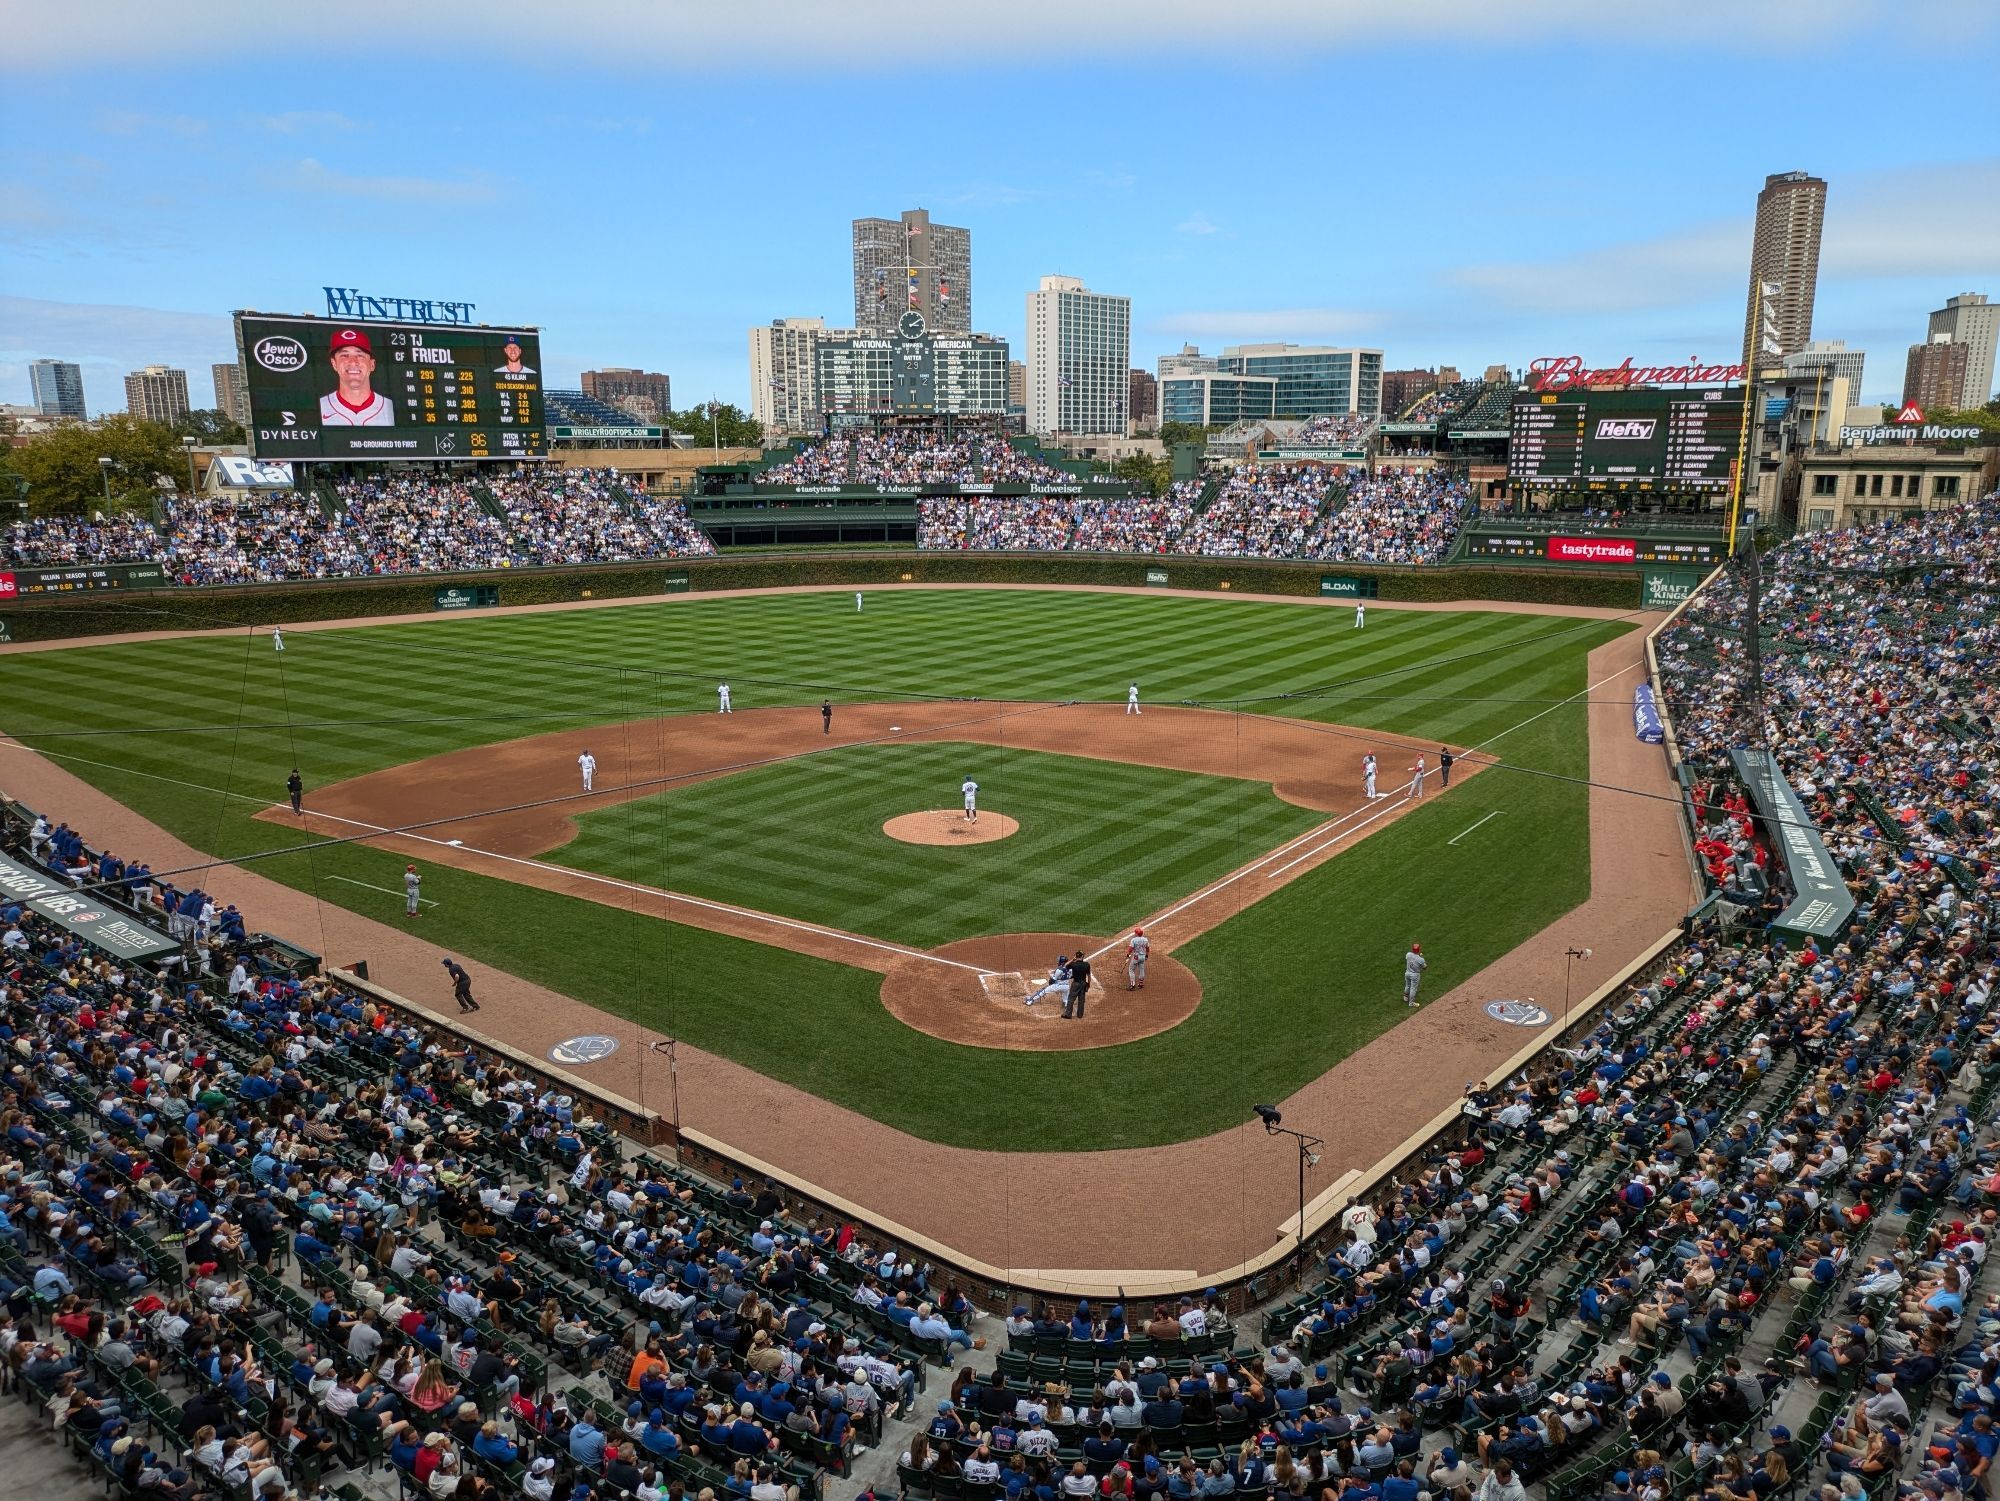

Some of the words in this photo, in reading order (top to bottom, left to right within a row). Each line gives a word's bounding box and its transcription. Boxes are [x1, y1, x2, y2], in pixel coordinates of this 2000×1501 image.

[322, 286, 476, 324] WINTRUST
[390, 334, 406, 345] 29
[410, 334, 422, 346] TJ
[261, 342, 297, 355] Jewel
[264, 354, 297, 365] Osco
[395, 352, 404, 361] CF
[412, 348, 454, 364] FRIEDL
[420, 370, 434, 380] 293
[459, 372, 473, 380] .225
[1530, 355, 1748, 391] Budweiser
[425, 385, 432, 394] 13
[461, 386, 473, 395] .310
[1541, 395, 1557, 404] REDS
[1704, 392, 1722, 400] CUBS
[425, 400, 434, 408] 55
[461, 400, 476, 409] .382
[427, 414, 435, 422] 35
[462, 414, 477, 422] .693
[261, 430, 318, 440] DYNEGY
[1600, 422, 1652, 438] Hefty
[1840, 426, 1917, 444] Benjamin
[1922, 426, 1980, 439] Moore
[471, 433, 487, 446] 86
[219, 456, 294, 484] Ra
[801, 485, 841, 494] tastytrade
[887, 485, 922, 493] Advocate
[1030, 484, 1083, 493] Budweiser
[1562, 544, 1633, 558] tastytrade
[1149, 574, 1167, 582] Hefty
[1650, 585, 1689, 593] DRAFT
[438, 595, 470, 604] Gallagher
[1654, 591, 1688, 600] KINGS
[28, 890, 87, 914] CUBS
[106, 921, 159, 948] WINTRUST
[1352, 1212, 1367, 1224] 27
[848, 1398, 864, 1411] 27
[935, 1428, 946, 1437] 27
[1030, 1438, 1048, 1446] RIZZO
[1244, 1469, 1251, 1484] 7
